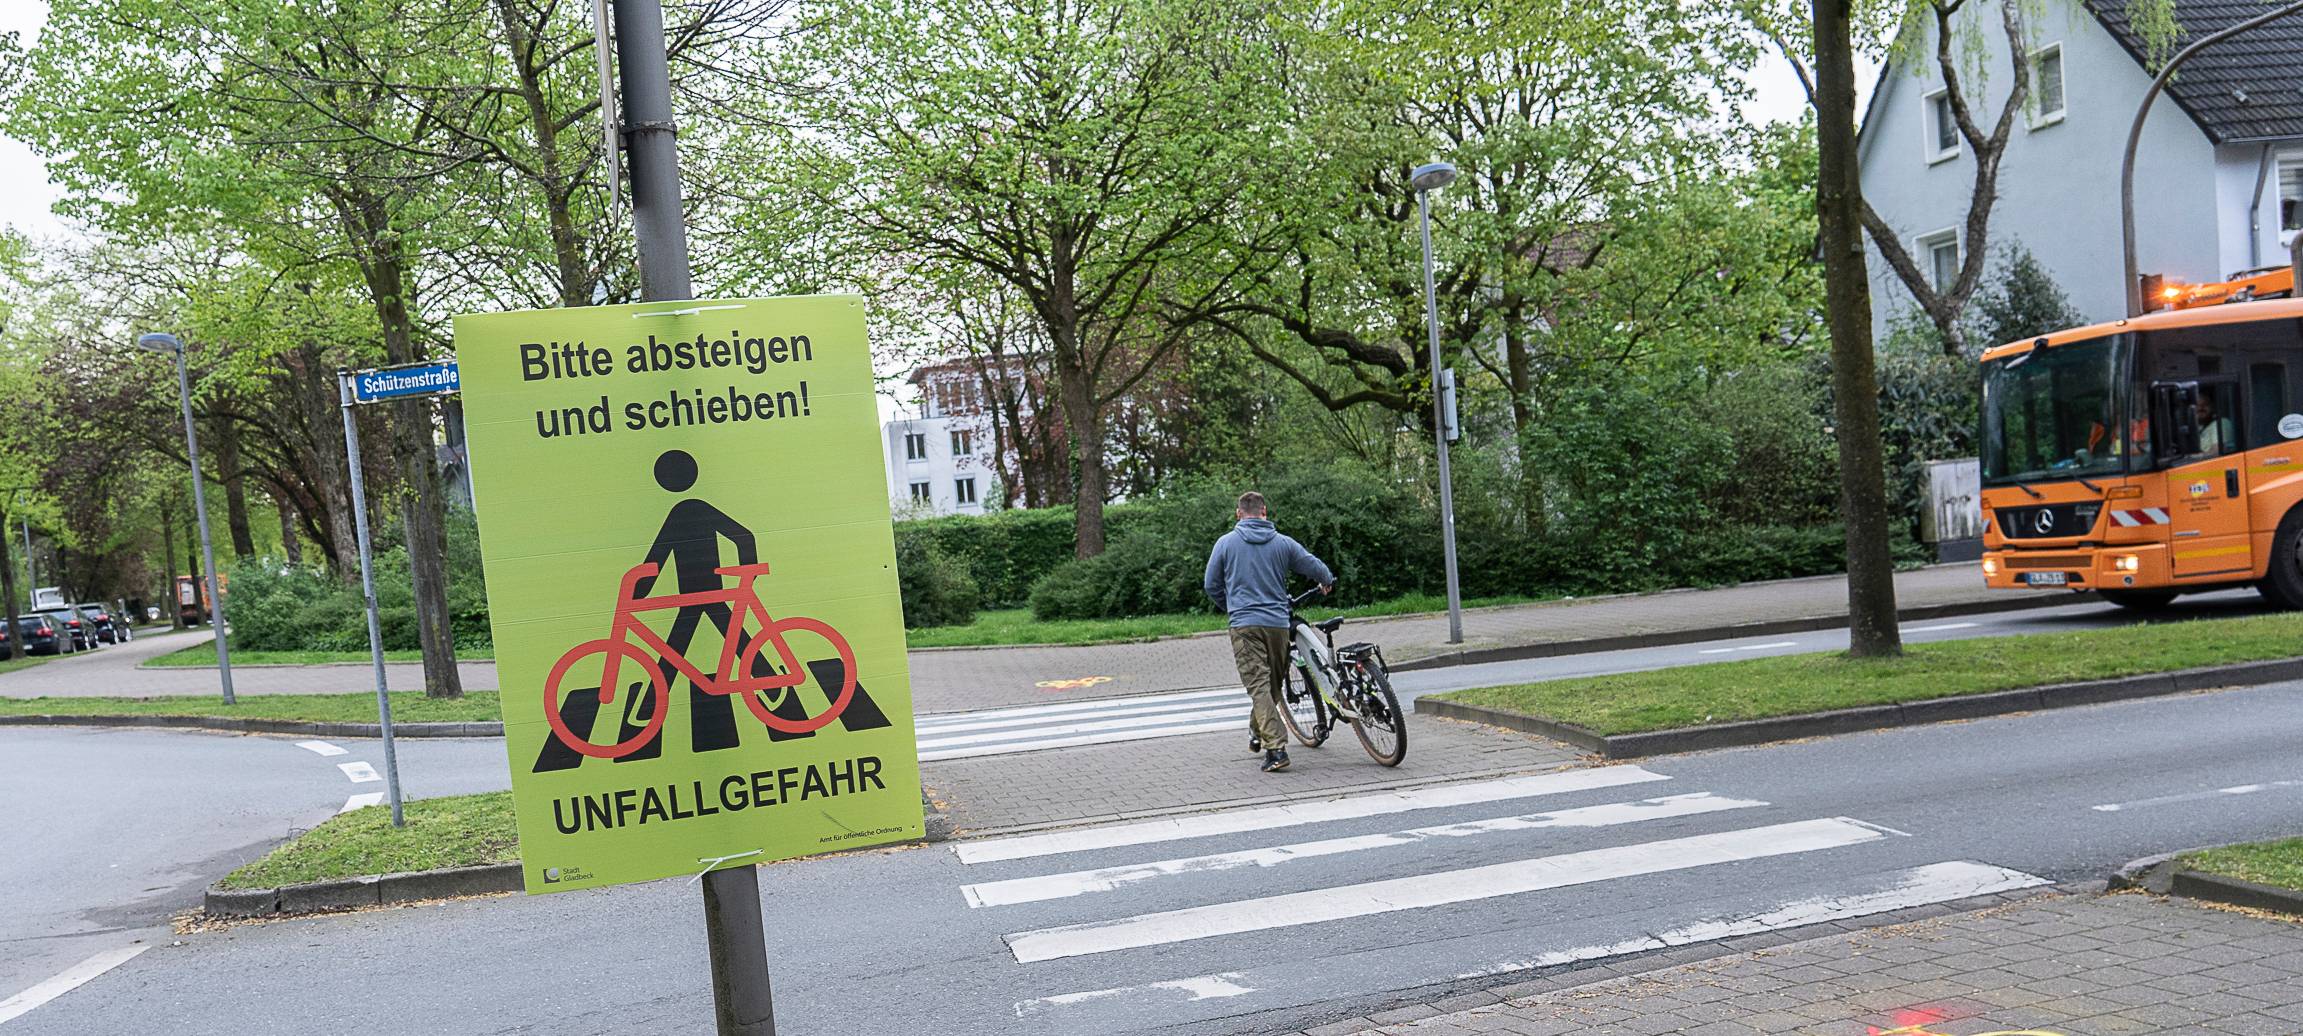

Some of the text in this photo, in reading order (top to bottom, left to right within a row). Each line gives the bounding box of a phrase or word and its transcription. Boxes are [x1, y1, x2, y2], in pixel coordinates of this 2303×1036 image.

[520, 330, 813, 382] Bitte absteigen
[364, 369, 457, 394] Schützenstraße
[536, 381, 811, 438] und schieben!
[553, 756, 886, 835] UNFALLGEFAHR
[819, 836, 833, 844] Amt
[843, 830, 875, 839] öffentliche
[876, 826, 902, 834] Ordnung
[564, 872, 593, 881] Gladbeck
